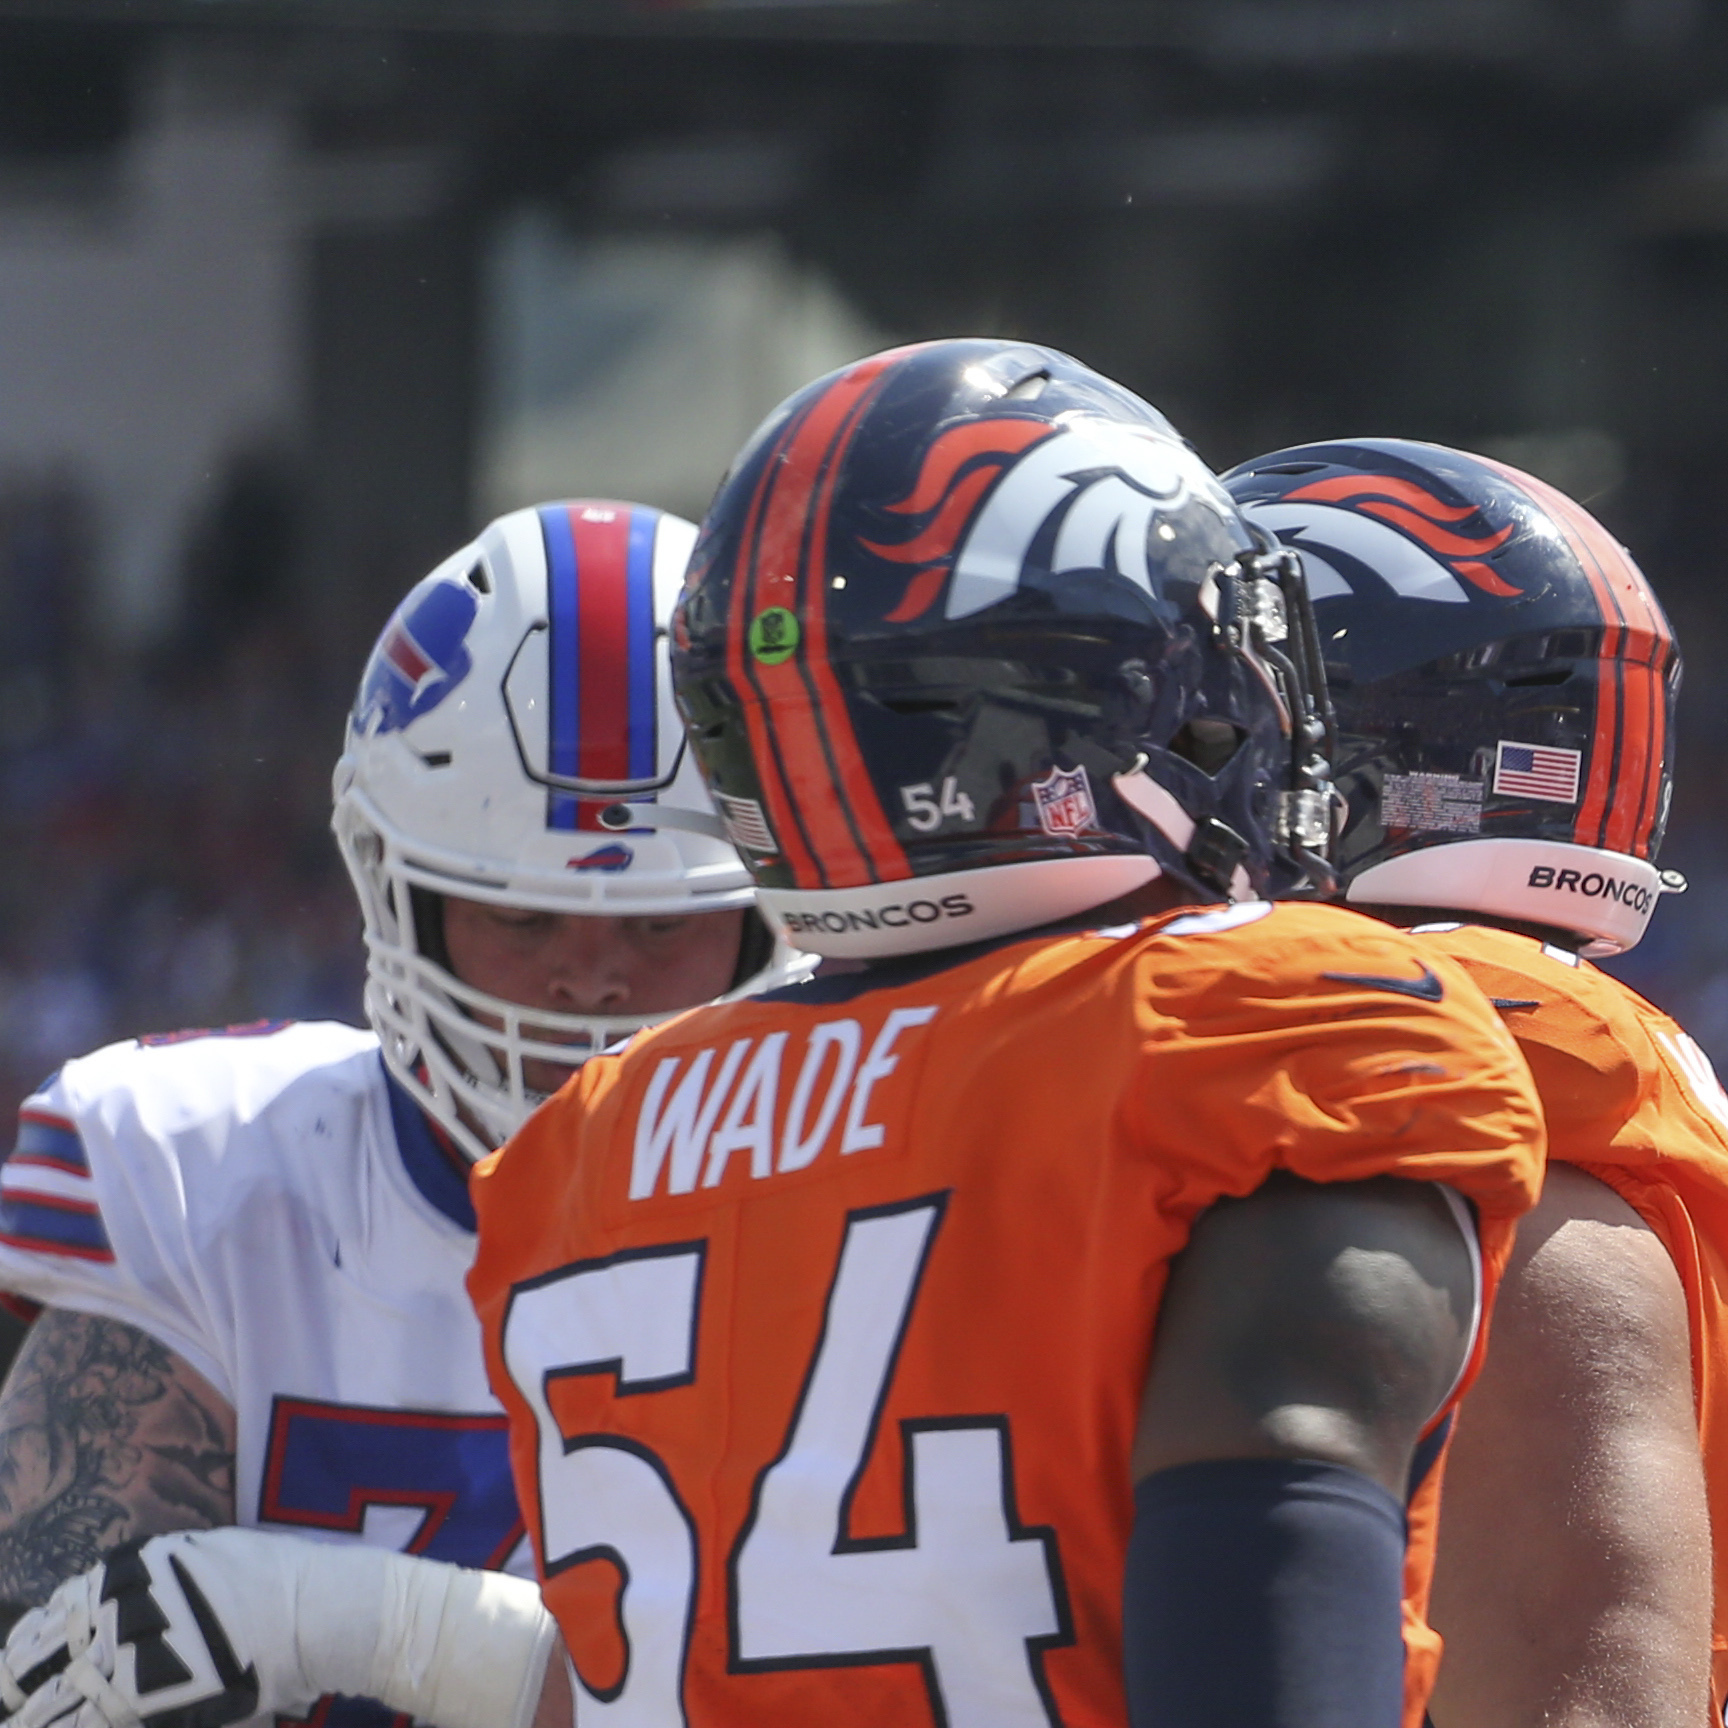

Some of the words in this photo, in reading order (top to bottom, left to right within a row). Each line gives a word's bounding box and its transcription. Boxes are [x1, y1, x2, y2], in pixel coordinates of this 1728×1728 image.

[901, 776, 976, 832] 54
[1046, 797, 1089, 829] NFL
[783, 894, 974, 934] BRONCOS
[1527, 866, 1653, 915] BRONCOS
[628, 1005, 940, 1202] WADE
